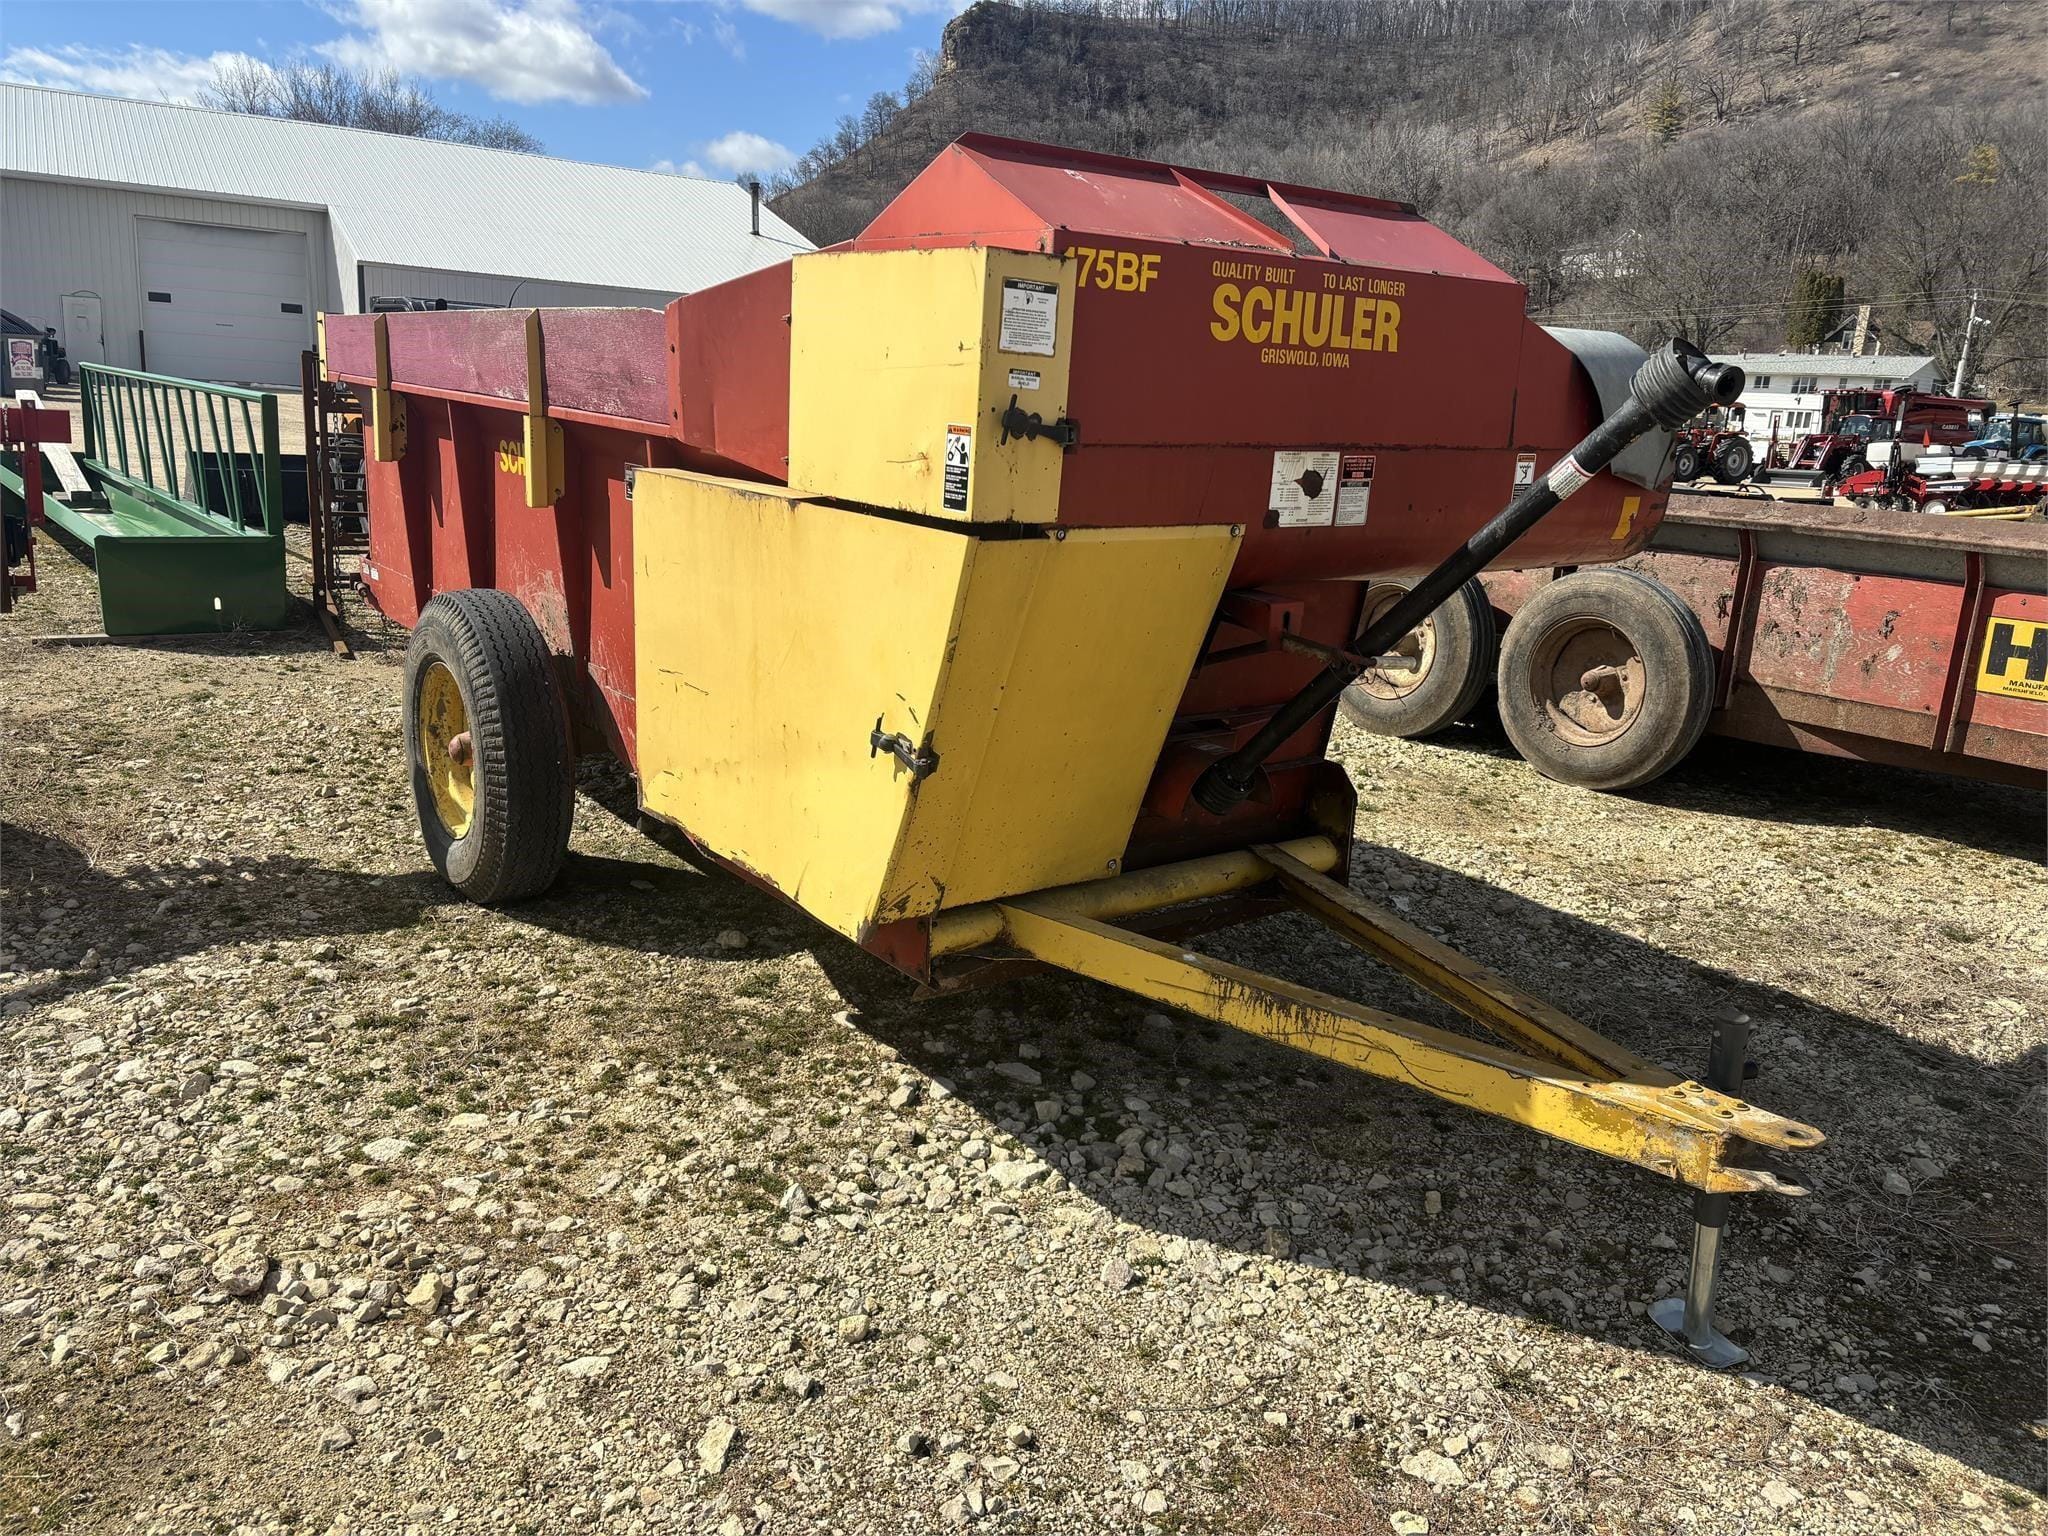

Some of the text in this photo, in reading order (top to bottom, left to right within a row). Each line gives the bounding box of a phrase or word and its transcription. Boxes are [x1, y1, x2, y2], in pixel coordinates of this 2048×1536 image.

[1212, 260, 1406, 296] QUALITY BUILT TO LAST LONGER
[1210, 283, 1401, 352] SCHULER
[1261, 347, 1350, 368] GRISWOLD, IOWA
